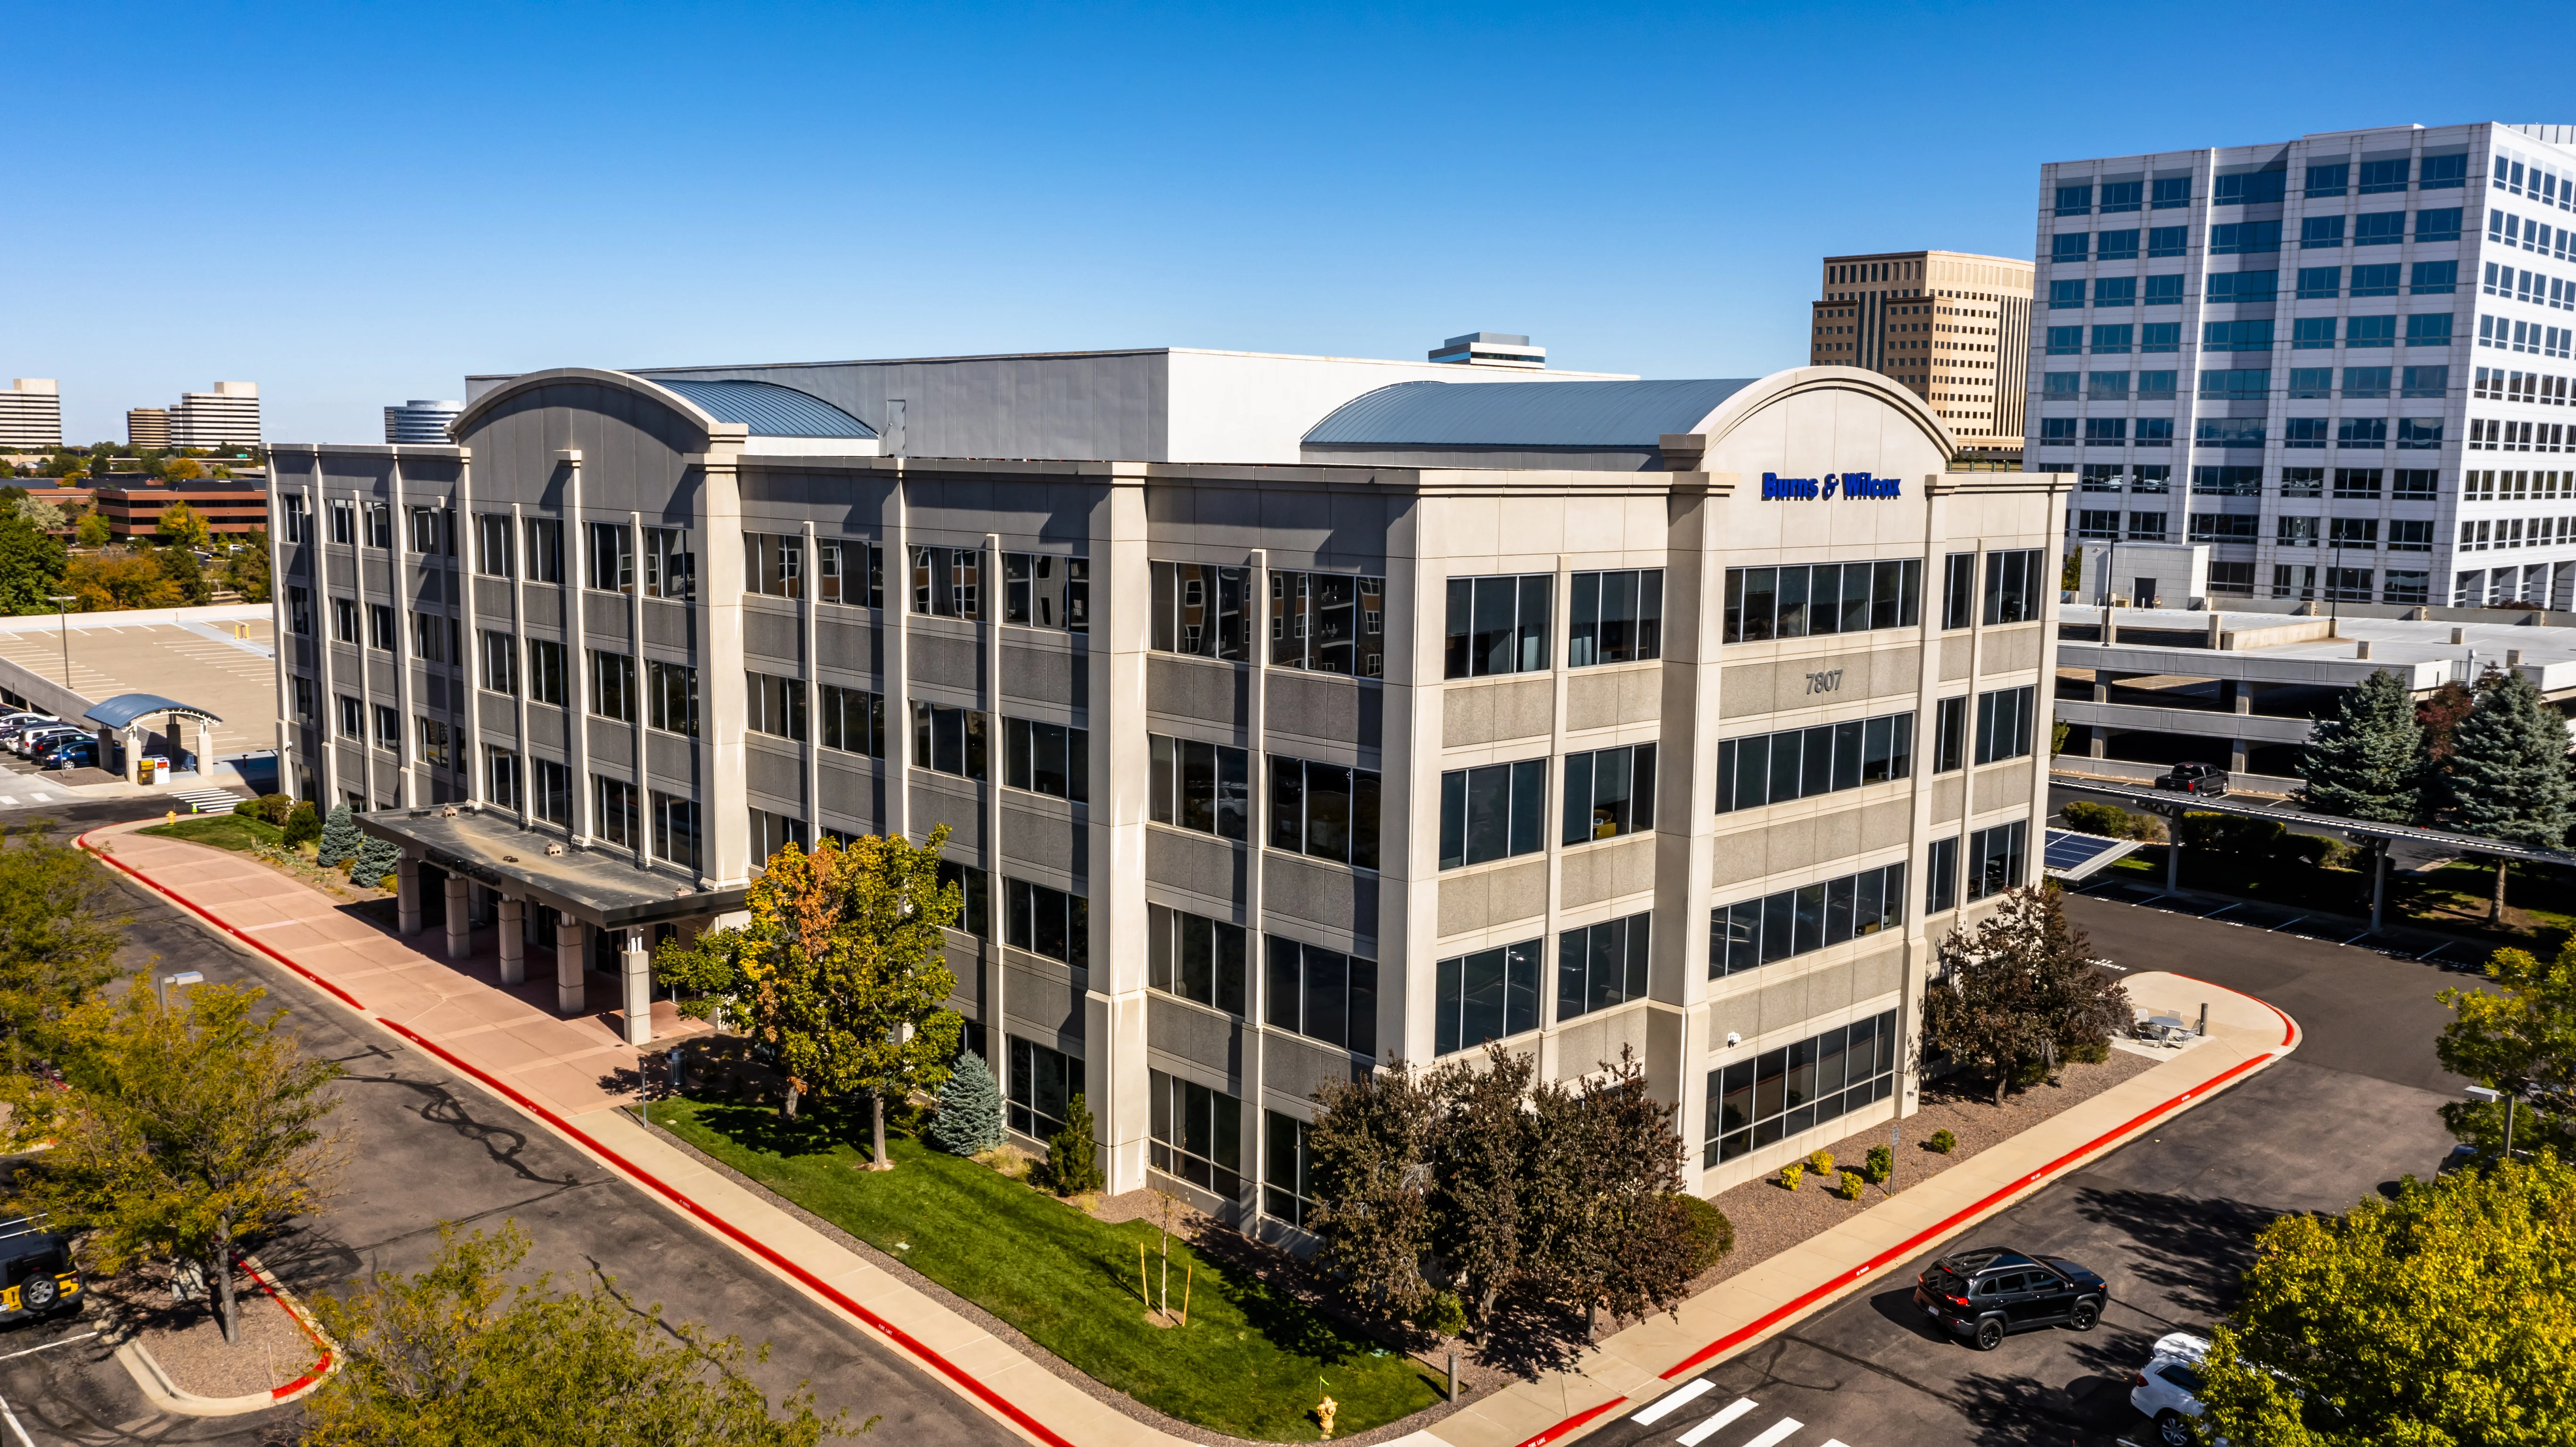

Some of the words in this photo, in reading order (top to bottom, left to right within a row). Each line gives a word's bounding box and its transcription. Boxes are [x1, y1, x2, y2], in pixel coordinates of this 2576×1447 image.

[1762, 472, 1819, 497] Burns
[1823, 473, 1839, 497] &
[1842, 472, 1901, 497] Wilcox
[1806, 669, 1843, 695] 7807
